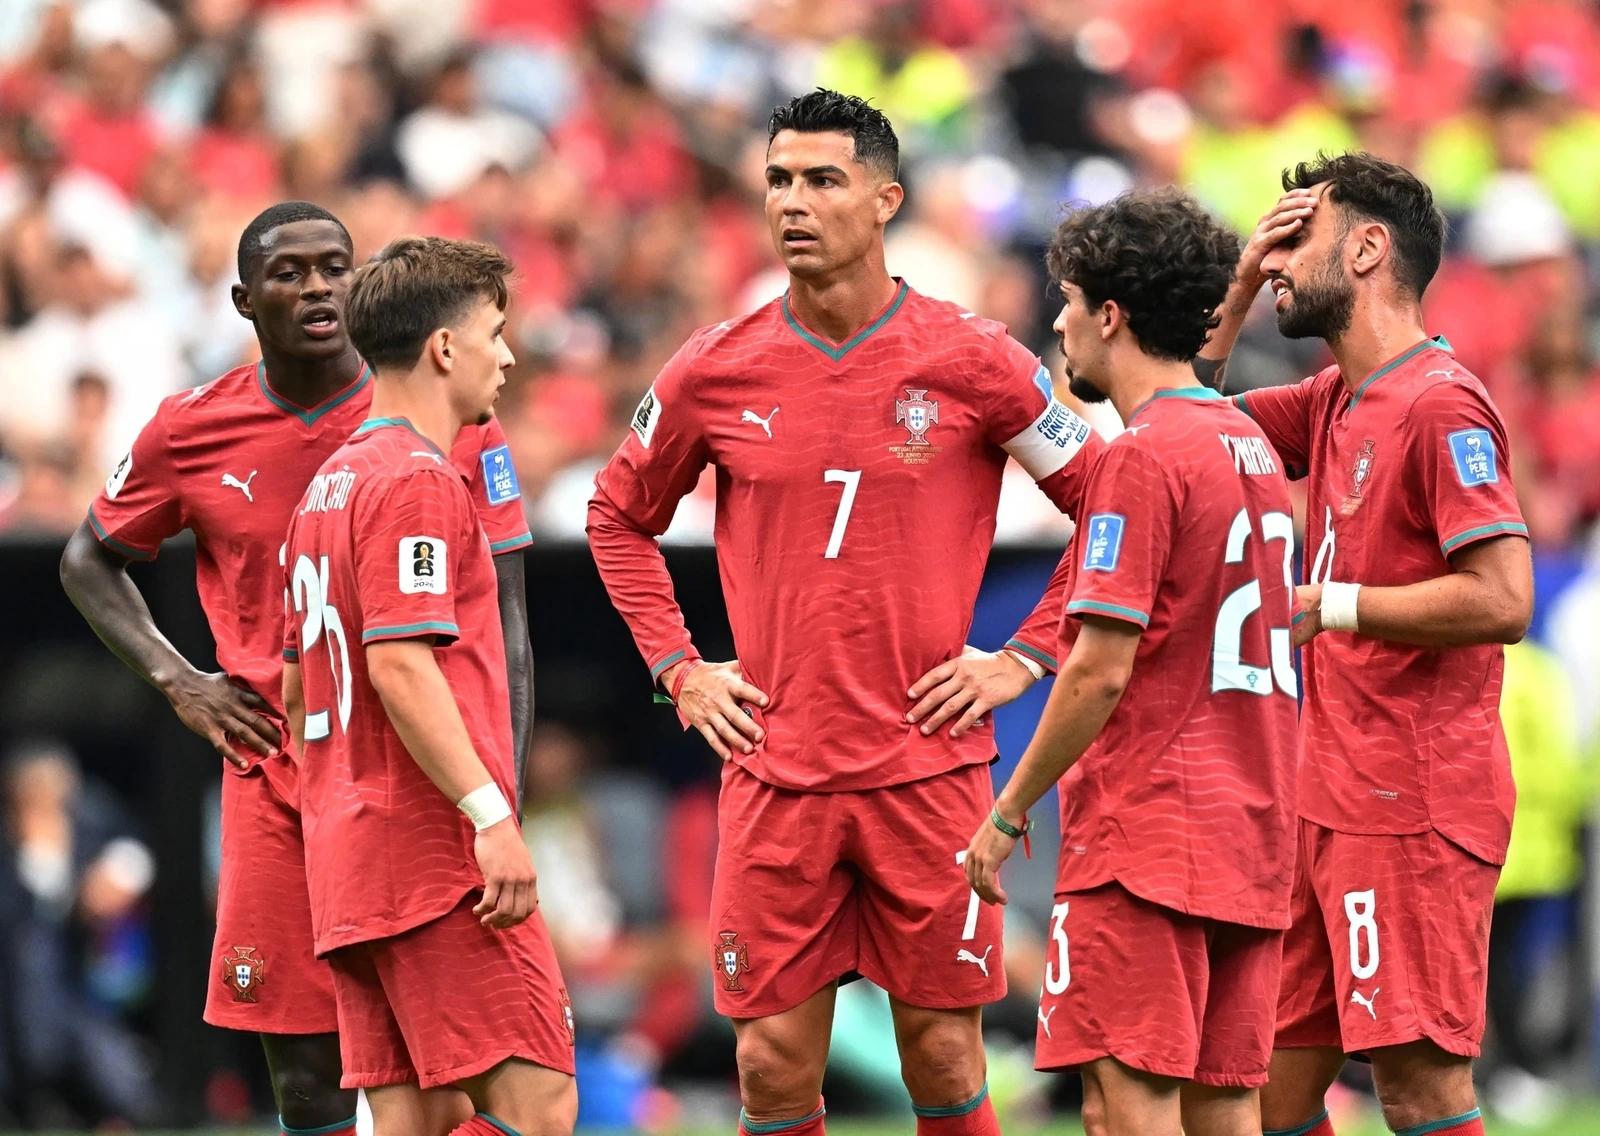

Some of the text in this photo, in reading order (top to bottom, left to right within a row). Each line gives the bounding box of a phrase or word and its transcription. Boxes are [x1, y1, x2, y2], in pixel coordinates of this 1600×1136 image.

[823, 468, 863, 559] 7
[292, 553, 353, 742] 26
[1343, 888, 1380, 980] 8
